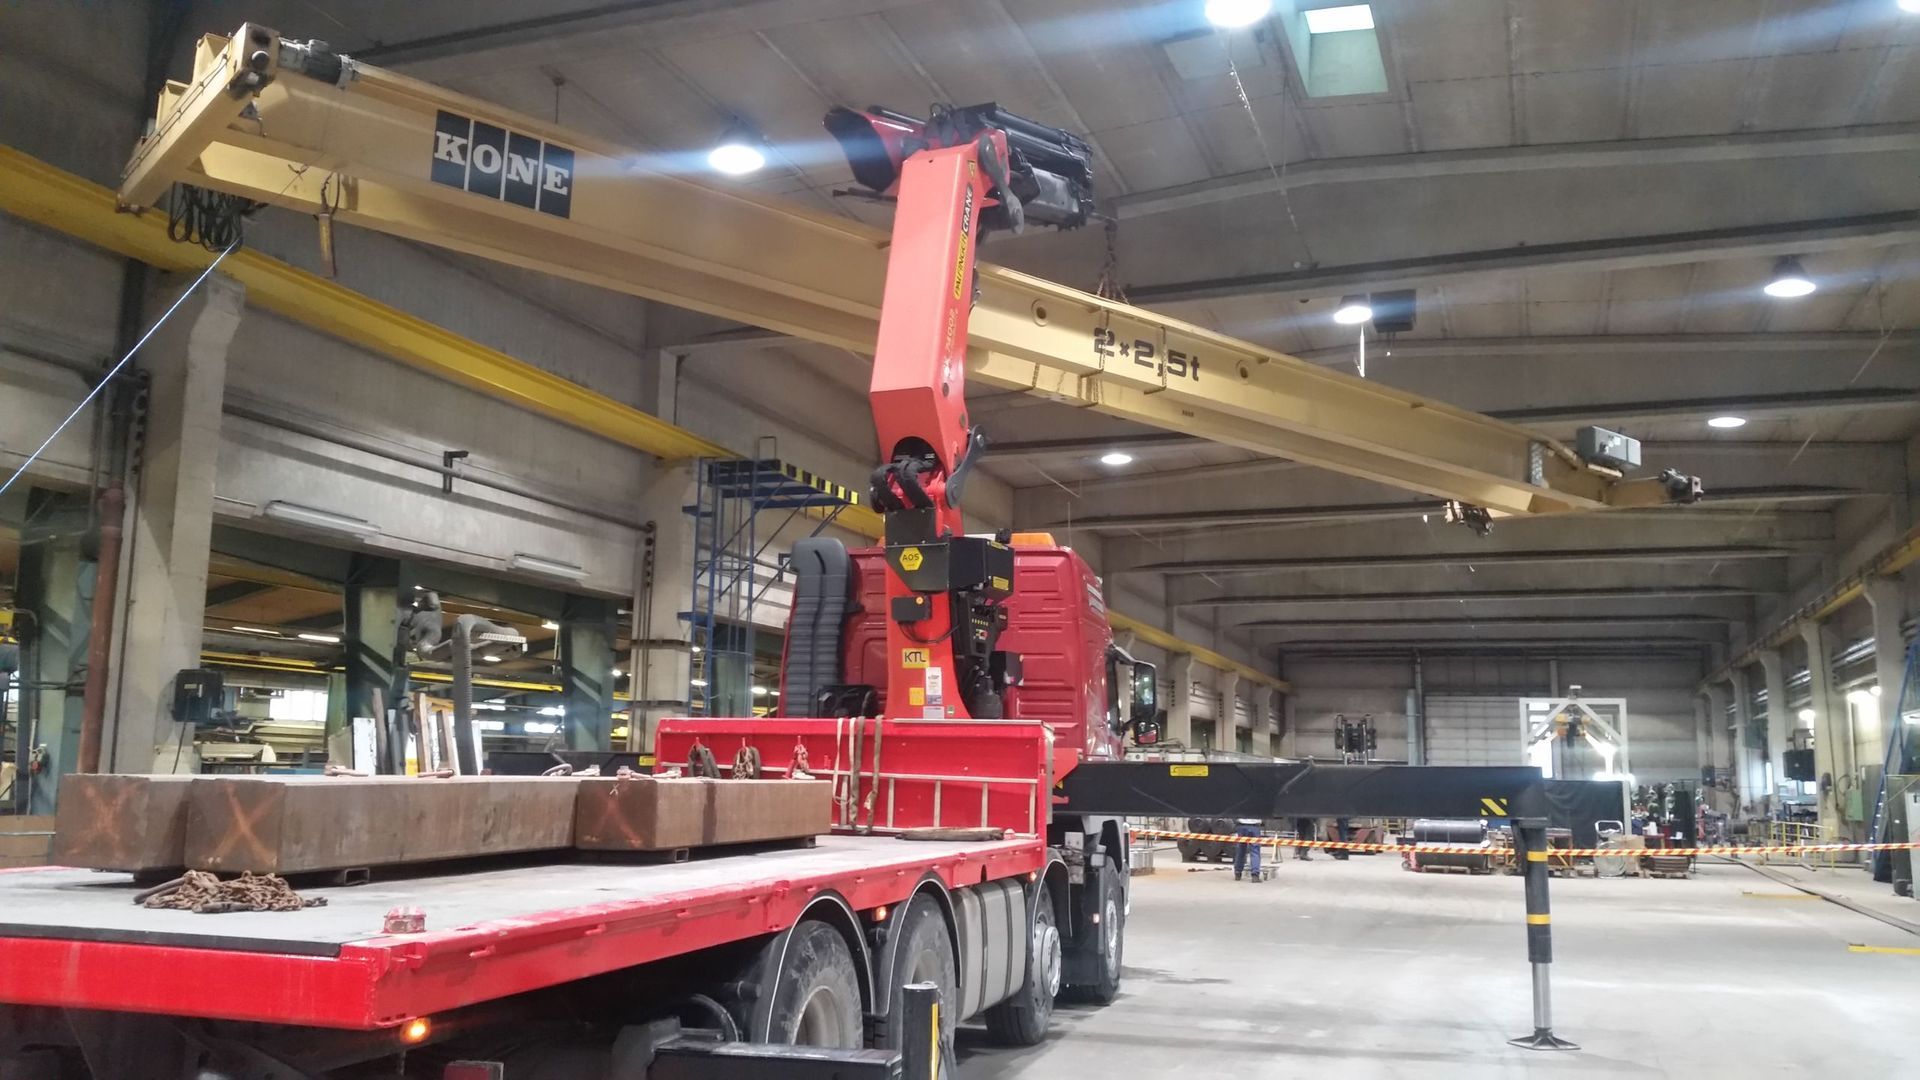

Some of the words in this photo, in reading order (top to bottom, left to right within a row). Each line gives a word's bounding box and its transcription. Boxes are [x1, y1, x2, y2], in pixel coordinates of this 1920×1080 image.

[434, 131, 569, 196] KONE
[962, 185, 973, 233] CRANE
[904, 651, 927, 663] KTL
